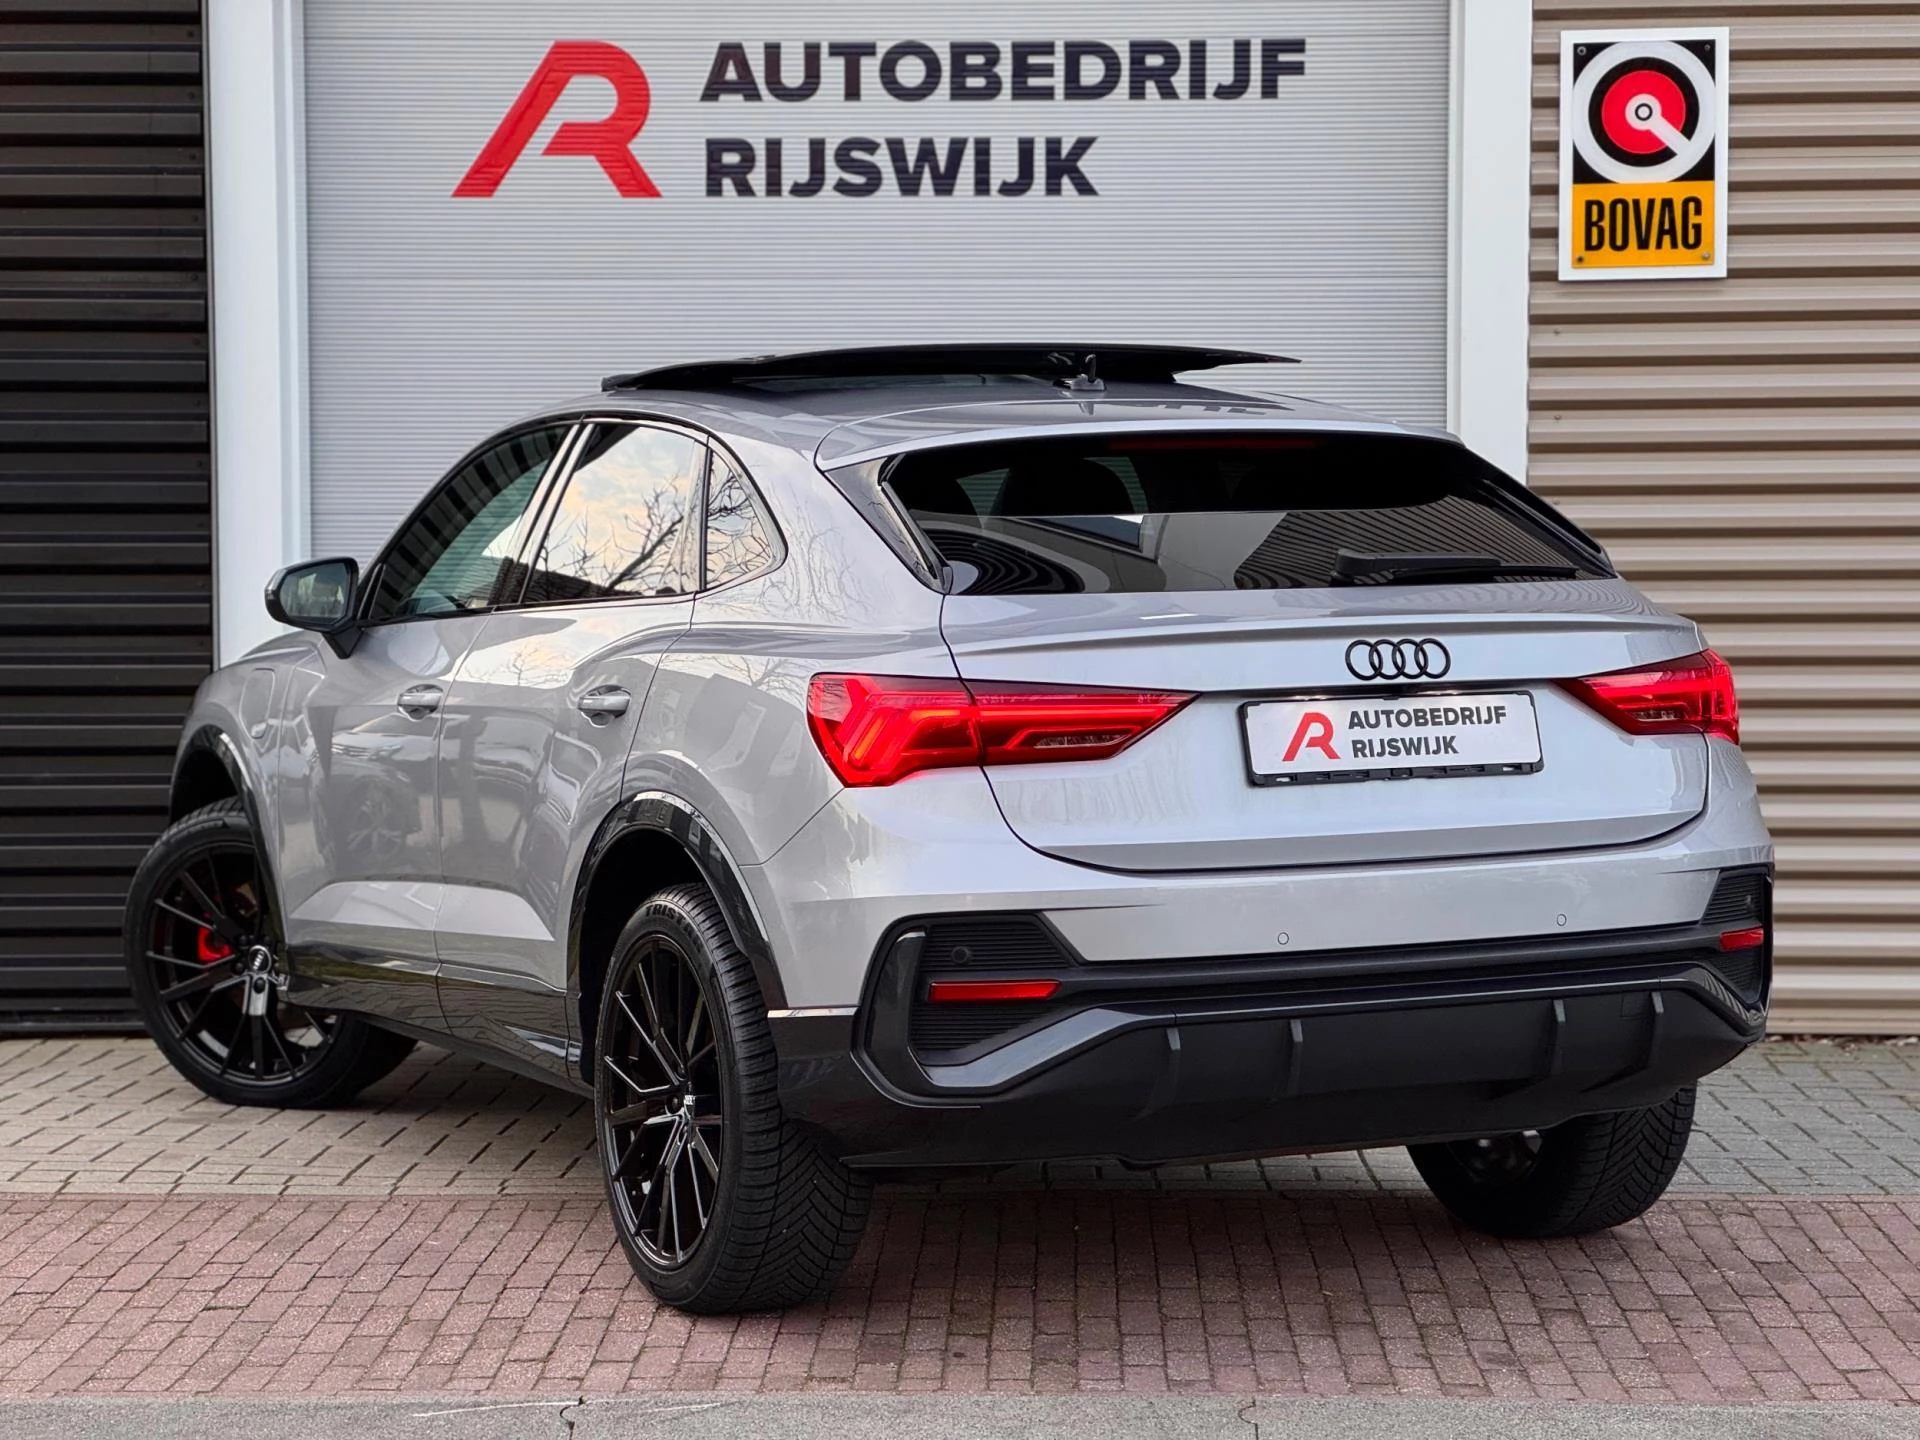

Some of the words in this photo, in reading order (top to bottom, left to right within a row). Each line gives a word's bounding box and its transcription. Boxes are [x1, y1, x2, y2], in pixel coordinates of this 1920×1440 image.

[700, 38, 1306, 103] AUTOBEDRIJF
[705, 136, 1099, 198] RIJSWIJK
[1584, 196, 1702, 252] BOVAG
[1348, 705, 1507, 730] AUTOBEDRIJF
[1351, 735, 1460, 759] RIJSWIJK
